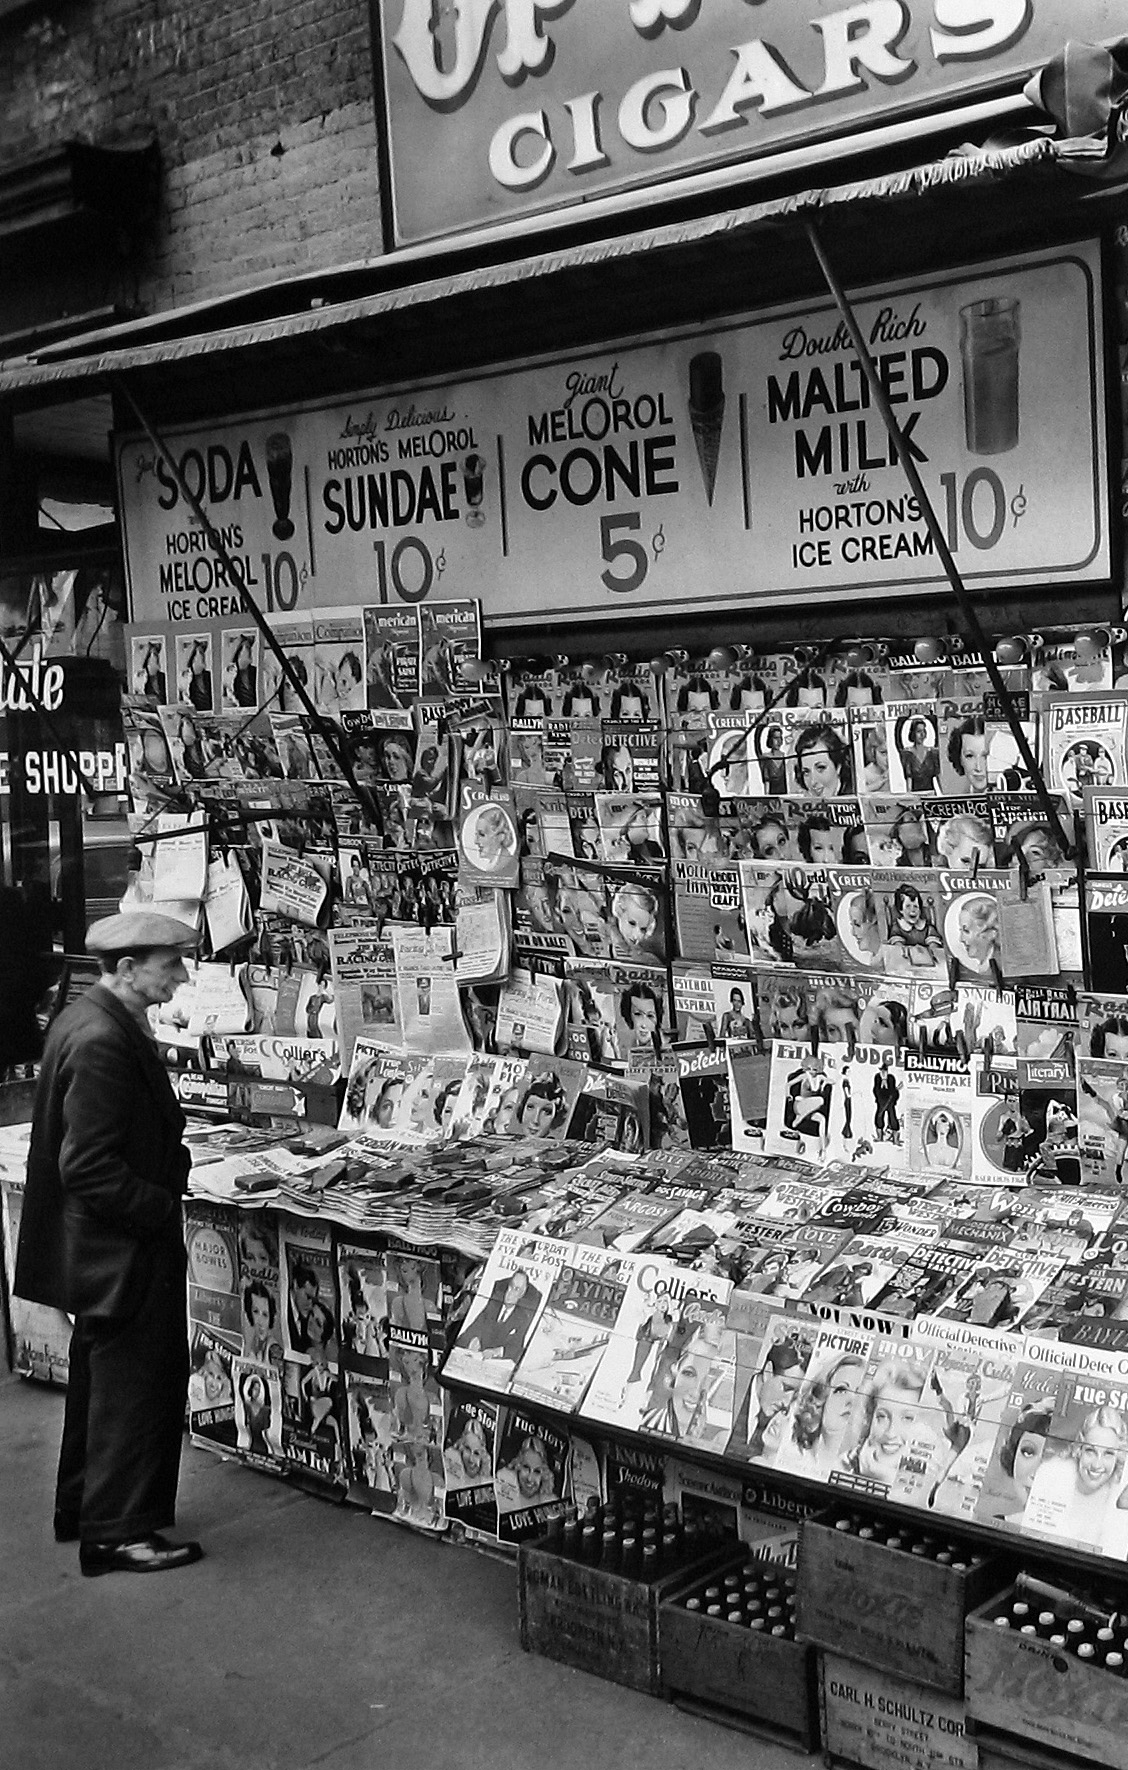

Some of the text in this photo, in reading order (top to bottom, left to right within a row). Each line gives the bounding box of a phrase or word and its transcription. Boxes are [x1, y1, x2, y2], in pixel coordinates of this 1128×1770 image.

[488, 0, 1034, 191] CIGARS
[869, 302, 927, 345] Rich
[767, 346, 950, 423] MALTED
[528, 392, 674, 446] MELOROL
[327, 427, 479, 470] HORTON'S MELOROL
[795, 412, 929, 478] MILK
[156, 440, 263, 510] SODA
[521, 434, 680, 511] CONE
[323, 462, 460, 535] SUNDAE
[799, 494, 925, 533] HORTON'S
[792, 532, 934, 568] ICE CREAM
[159, 555, 258, 593] MELOROL
[167, 602, 192, 621] ICE
[1055, 704, 1122, 732] BASEBALL
[605, 733, 658, 750] DETECTIVE
[939, 871, 1013, 900] SCREENLAND
[273, 1039, 326, 1063] Collier's
[618, 1199, 670, 1218] ARGOSY
[668, 1185, 709, 1200] SAVAGE
[501, 1232, 520, 1245] THE
[540, 1254, 568, 1268] POST
[581, 1250, 602, 1264] THE
[636, 1263, 720, 1304] Collier's
[818, 1333, 870, 1358] PICTURE
[917, 1319, 1017, 1354] Official Detective
[1028, 1345, 1077, 1370] Official
[830, 1681, 935, 1730] CARL H. SCHULTZ
